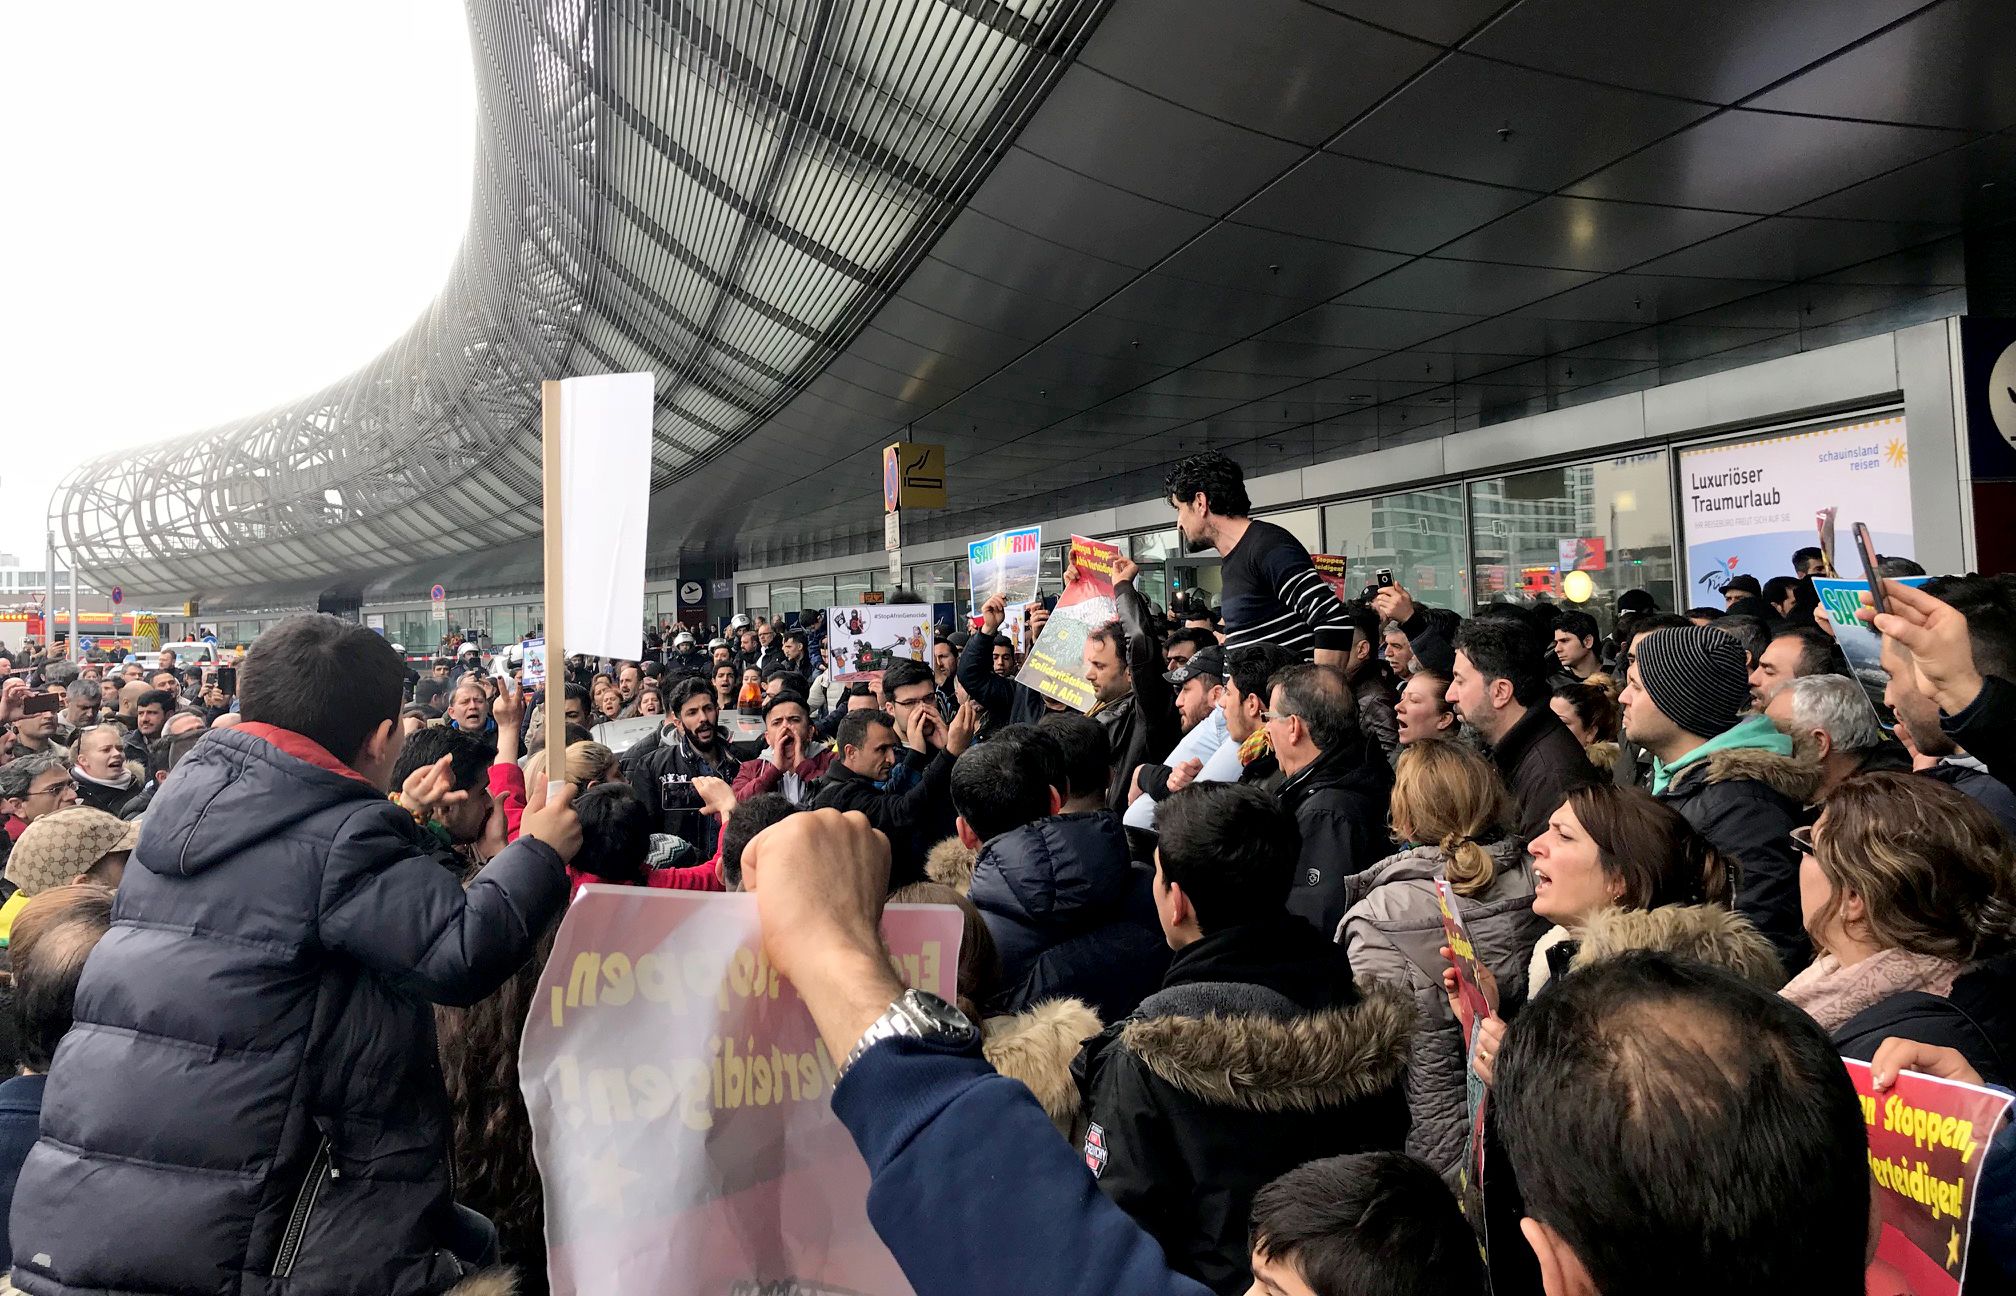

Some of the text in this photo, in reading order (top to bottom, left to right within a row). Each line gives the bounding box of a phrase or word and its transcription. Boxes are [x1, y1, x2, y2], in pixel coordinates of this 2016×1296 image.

[1818, 444, 1879, 463] schauinsland
[1850, 458, 1880, 471] reisen
[1692, 468, 1763, 490] Luxuriöser
[1692, 487, 1781, 512] Traumurlaub
[1822, 588, 1869, 628] SAV
[1039, 680, 1083, 707] mit Afrin
[1883, 1094, 1978, 1164] Stoppen,
[1867, 1147, 1965, 1220] erteidigen!
